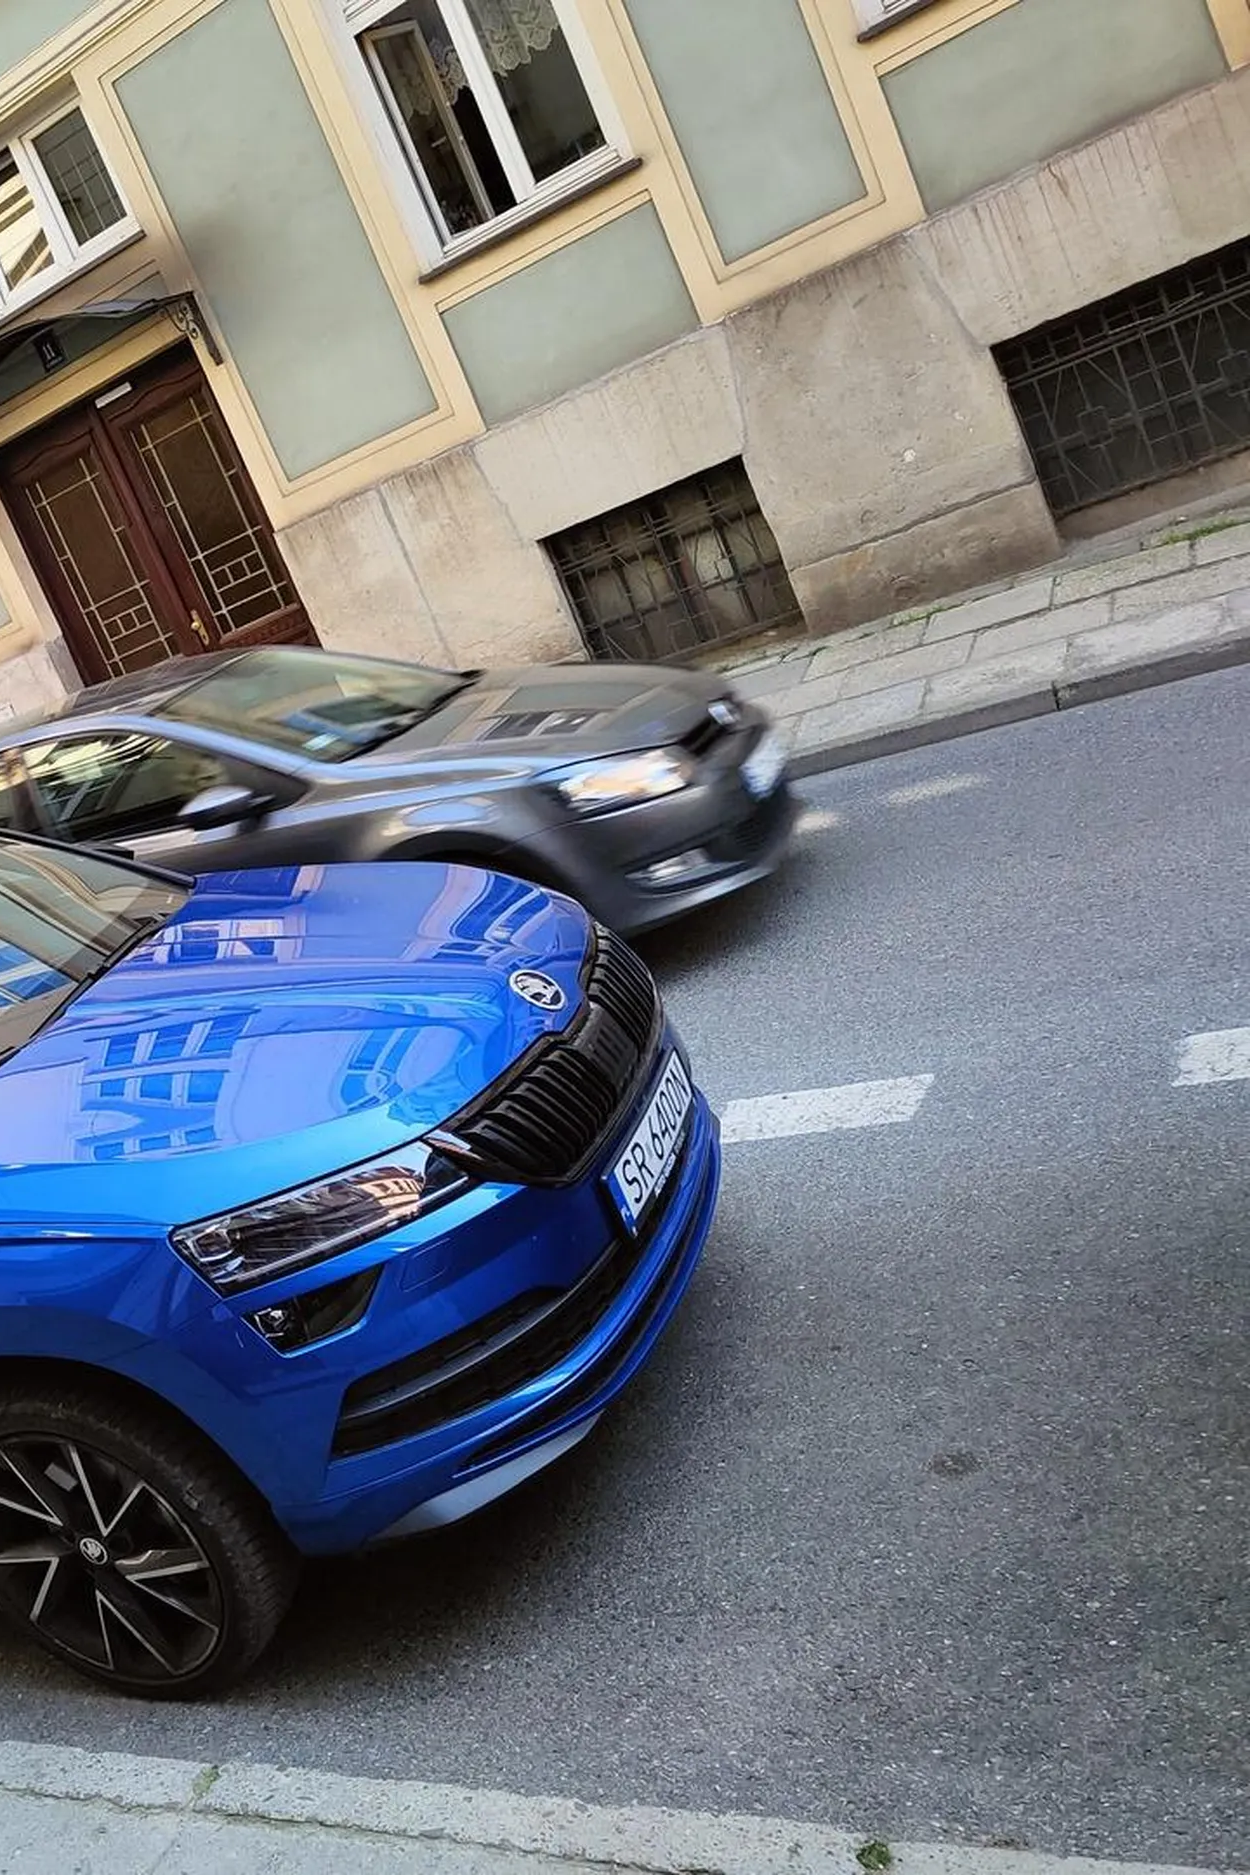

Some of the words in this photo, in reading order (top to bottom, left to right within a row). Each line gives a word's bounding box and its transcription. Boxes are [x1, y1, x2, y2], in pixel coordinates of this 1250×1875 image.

[42, 343, 55, 359] 11
[622, 1142, 655, 1204] SR
[648, 1059, 689, 1160] 6400N
